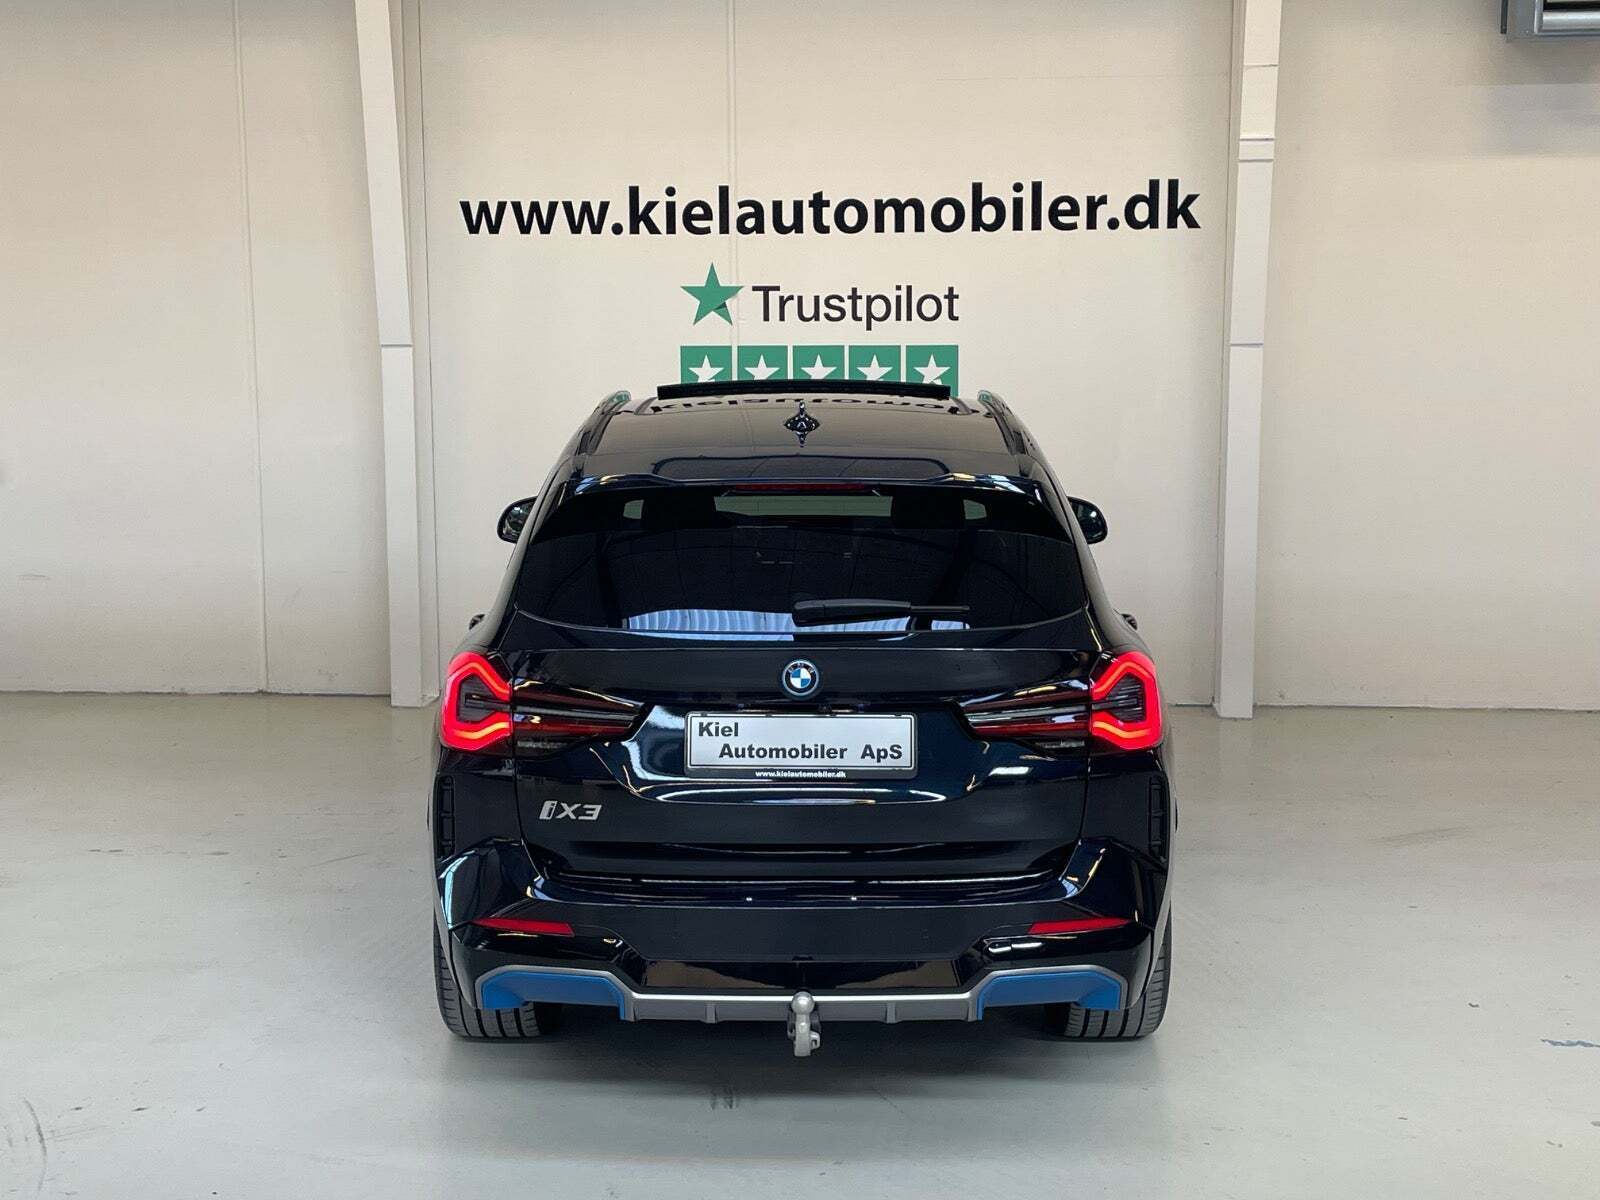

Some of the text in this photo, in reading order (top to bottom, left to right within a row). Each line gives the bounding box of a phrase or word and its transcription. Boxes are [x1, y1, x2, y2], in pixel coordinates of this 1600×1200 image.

[460, 179, 1201, 236] www.kielautomobiler.dk
[751, 284, 960, 331] Trustpilot
[698, 721, 739, 737] Kiel
[718, 743, 903, 763] Automobiler ApS
